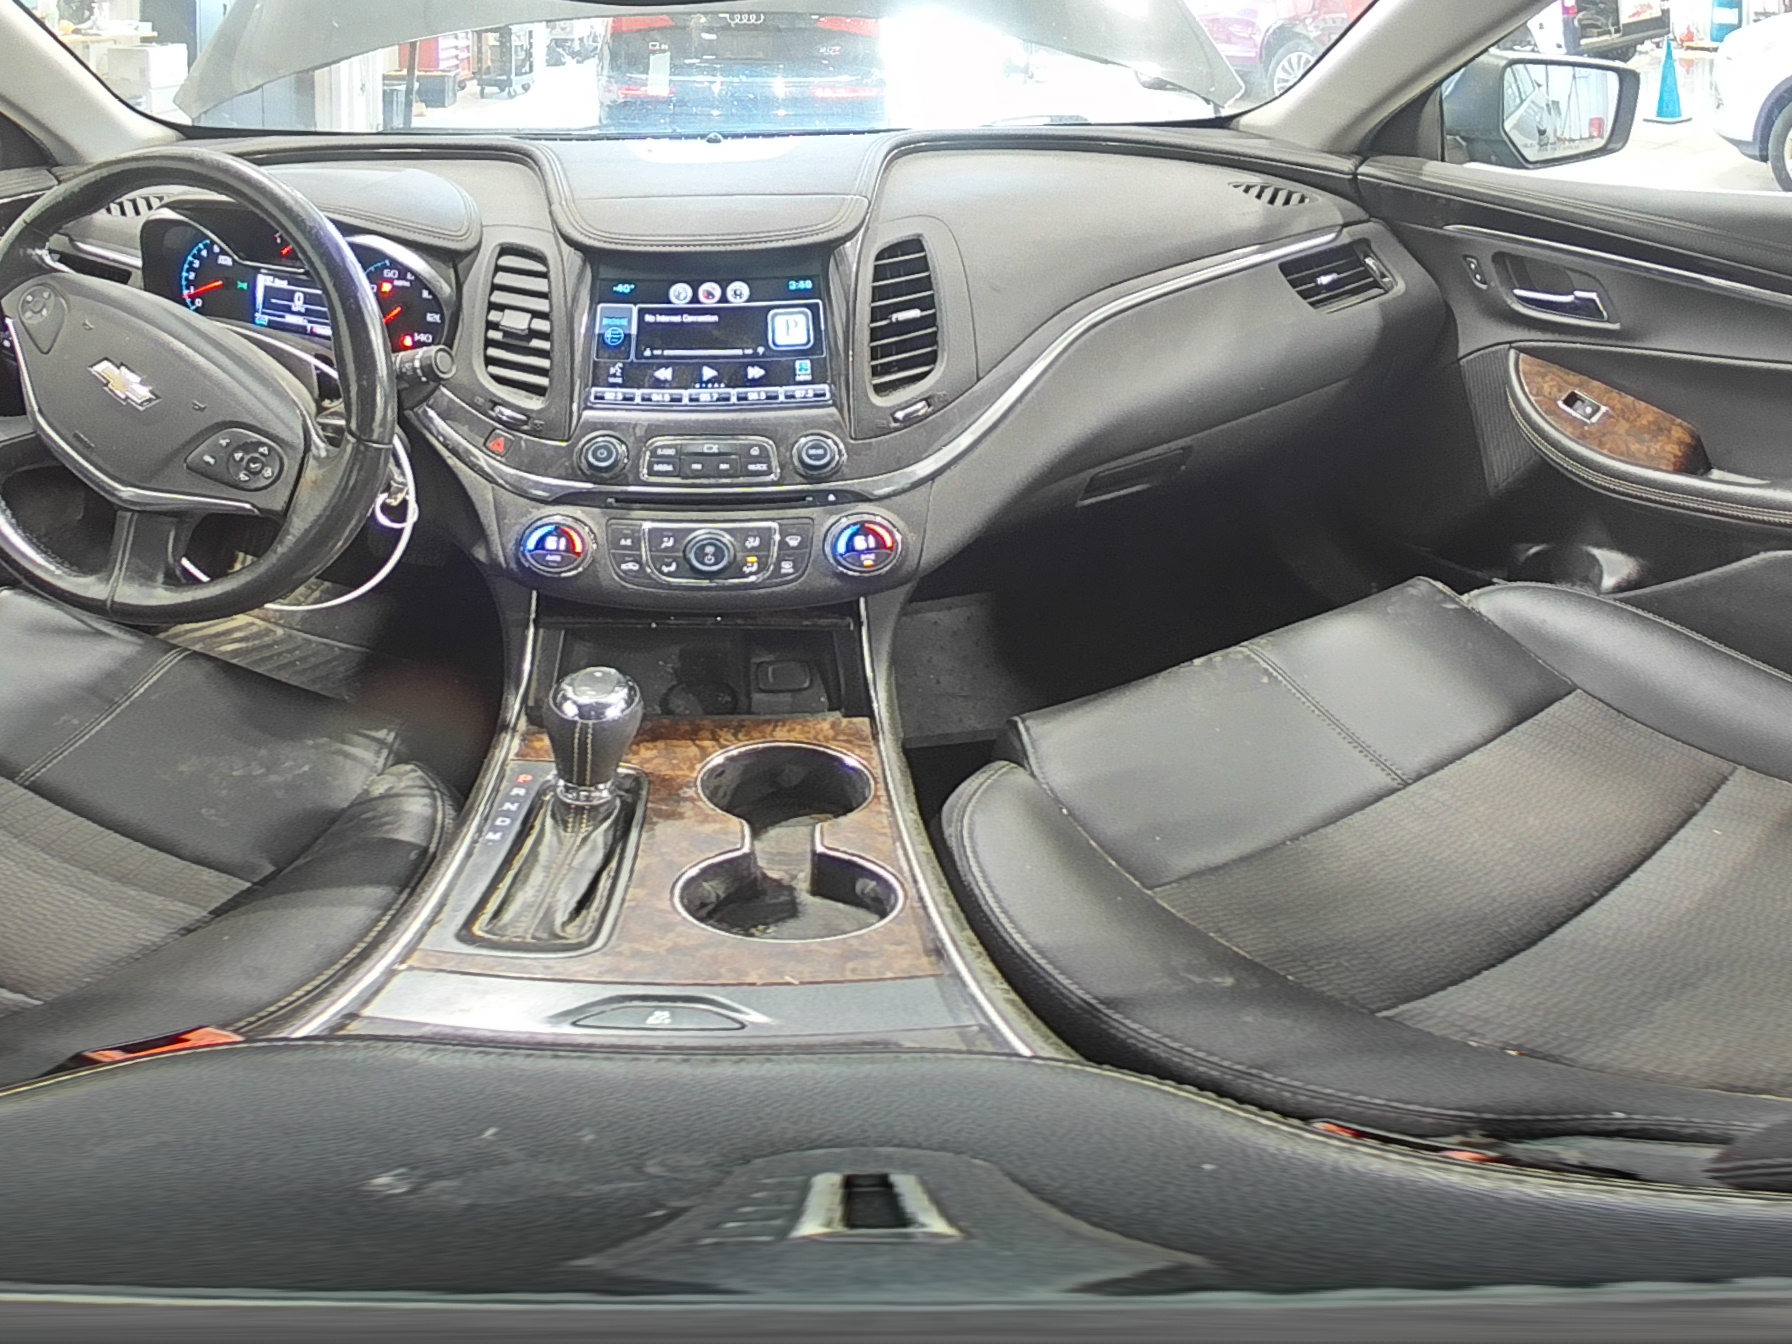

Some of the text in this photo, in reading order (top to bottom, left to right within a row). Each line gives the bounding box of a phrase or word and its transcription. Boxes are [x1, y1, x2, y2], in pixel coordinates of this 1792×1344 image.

[193, 259, 200, 268] 3
[189, 271, 195, 279] 2
[383, 269, 398, 278] 60
[195, 298, 202, 307] 0
[294, 292, 304, 306] 0
[414, 332, 432, 343] 140
[516, 774, 533, 784] P
[510, 787, 526, 796] R
[498, 802, 520, 811] N
[494, 817, 511, 826] D
[485, 831, 503, 840] M
